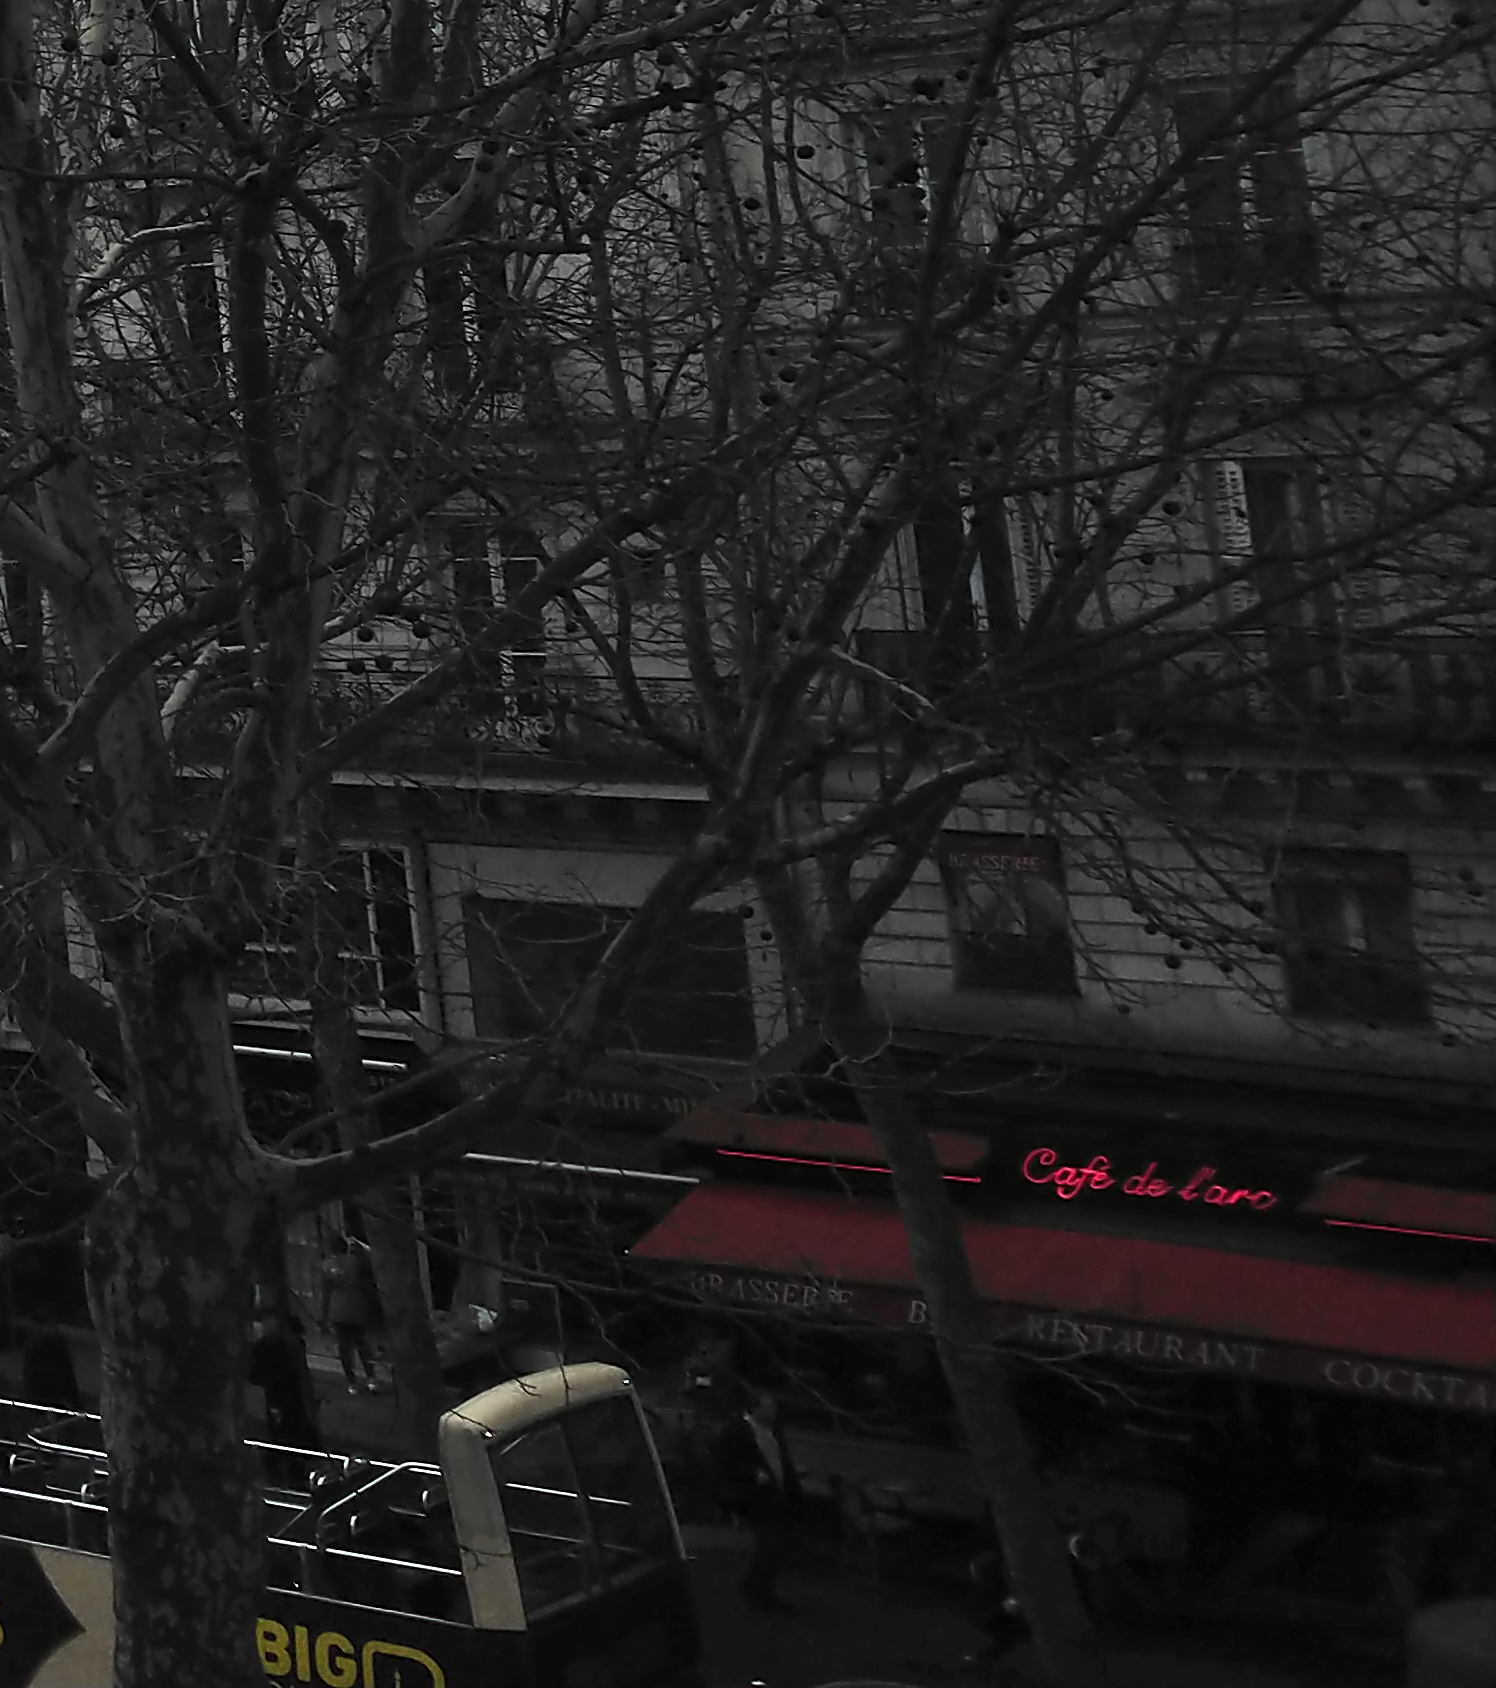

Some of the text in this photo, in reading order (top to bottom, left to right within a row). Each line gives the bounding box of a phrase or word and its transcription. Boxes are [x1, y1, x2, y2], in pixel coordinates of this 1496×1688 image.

[1023, 1147, 1117, 1201] Café
[1122, 1161, 1175, 1198] de
[1026, 1314, 1266, 1372] RESTAURANT
